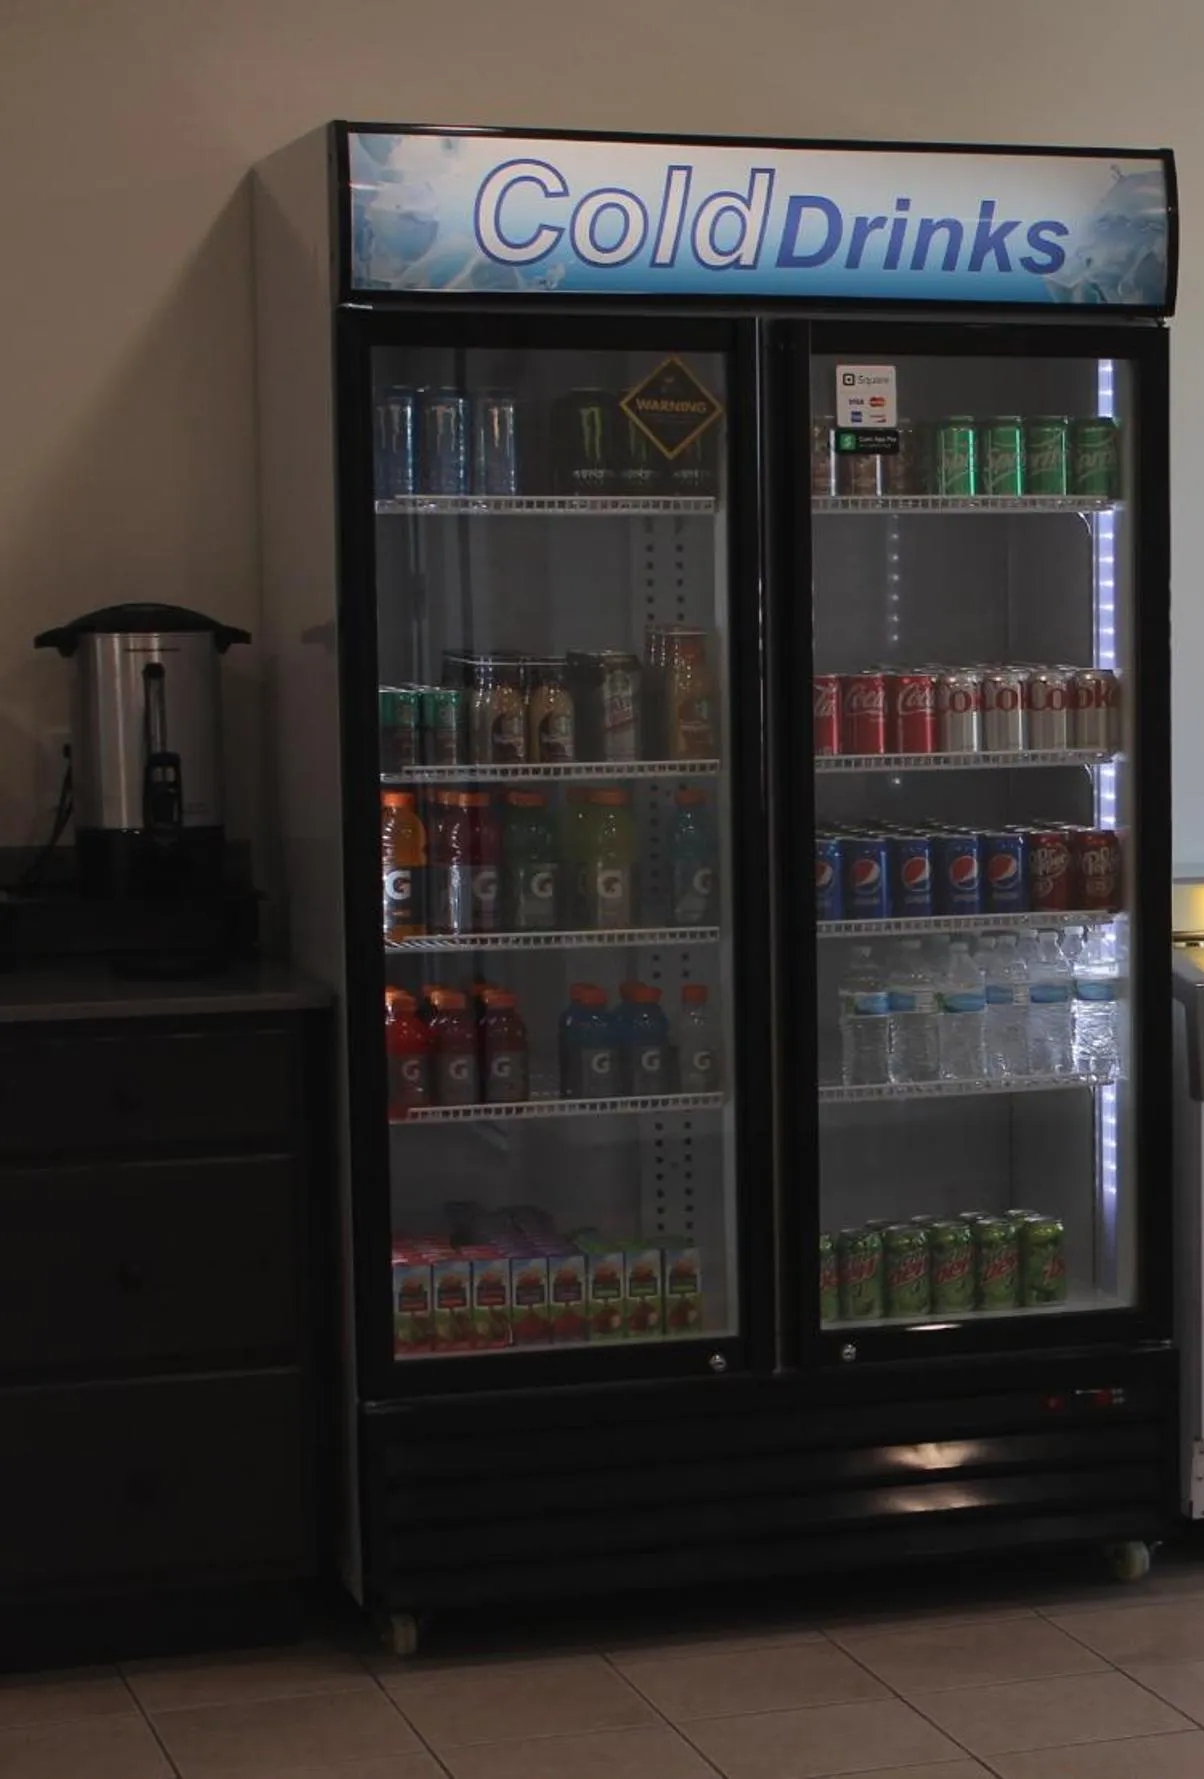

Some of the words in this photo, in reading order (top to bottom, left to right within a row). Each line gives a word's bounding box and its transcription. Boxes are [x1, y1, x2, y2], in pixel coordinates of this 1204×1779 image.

[474, 158, 776, 270] Cold
[775, 195, 1070, 275] Drinks
[635, 398, 708, 414] WARNING
